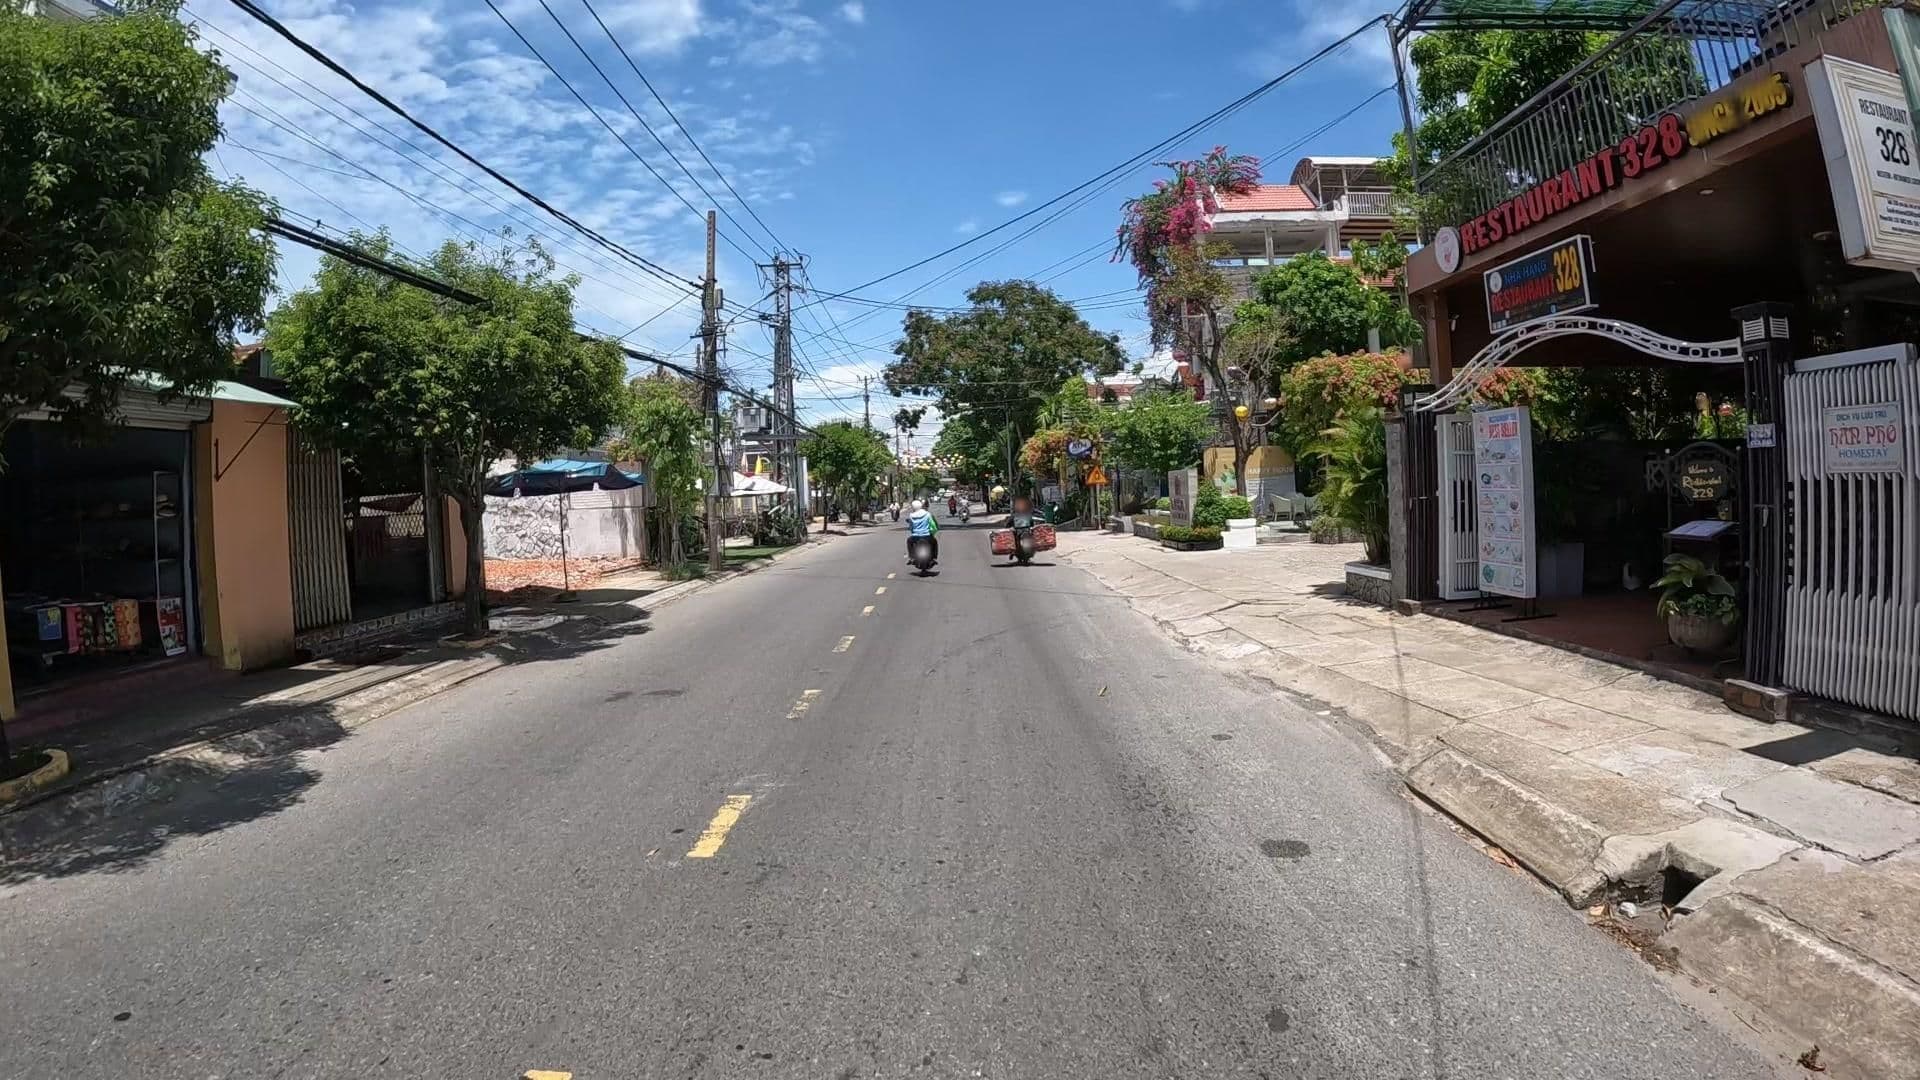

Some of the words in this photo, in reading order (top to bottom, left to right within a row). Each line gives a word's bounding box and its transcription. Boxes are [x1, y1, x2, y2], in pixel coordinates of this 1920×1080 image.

[1858, 98, 1909, 126] RESTAURANT
[1875, 126, 1910, 167] 328
[1460, 148, 1615, 255] RESTAURANT
[1619, 113, 1684, 178] 328
[1491, 273, 1555, 313] RESTAURANT
[1553, 245, 1580, 293] 328
[1839, 448, 1889, 458] HOMESTAY
[1693, 487, 1714, 498] 328
